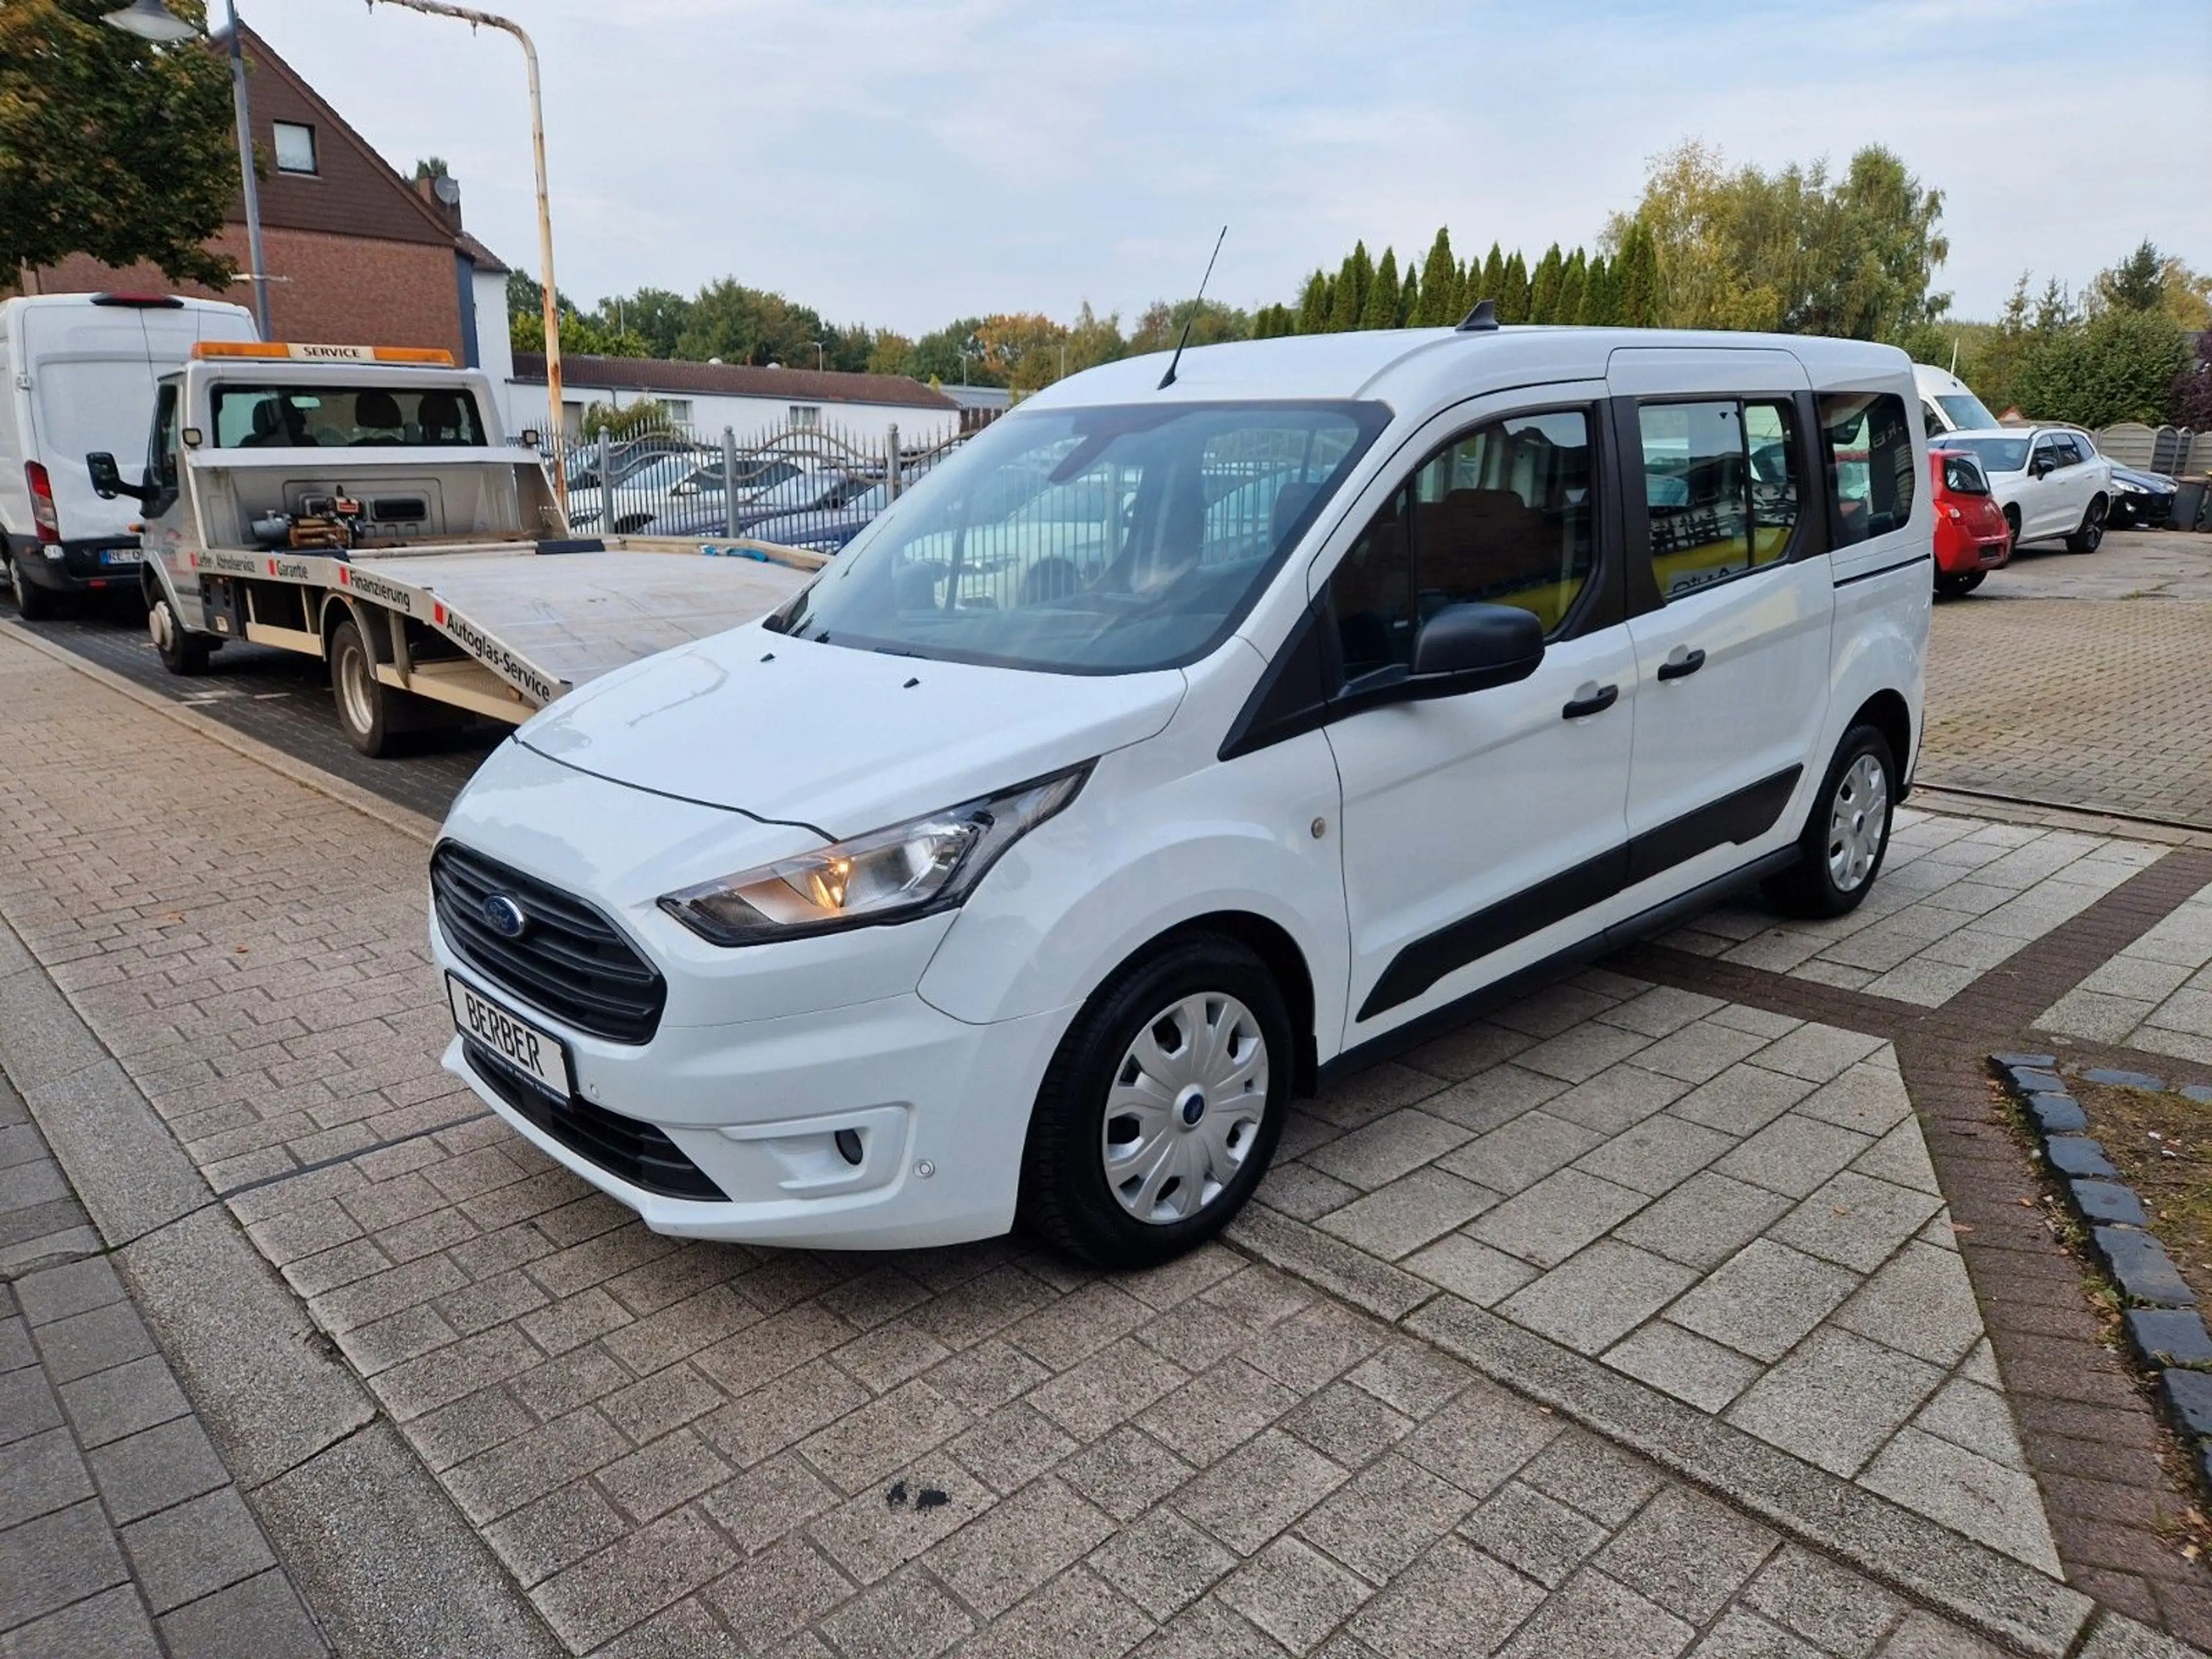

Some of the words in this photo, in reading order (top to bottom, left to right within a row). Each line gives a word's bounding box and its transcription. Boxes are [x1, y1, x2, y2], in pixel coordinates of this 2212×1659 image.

[303, 346, 360, 358] SERVICE
[276, 559, 308, 579] Garantie
[349, 570, 411, 612] Finanzierung
[446, 612, 550, 702] Autoglas-Service
[465, 991, 544, 1077] BERBER
